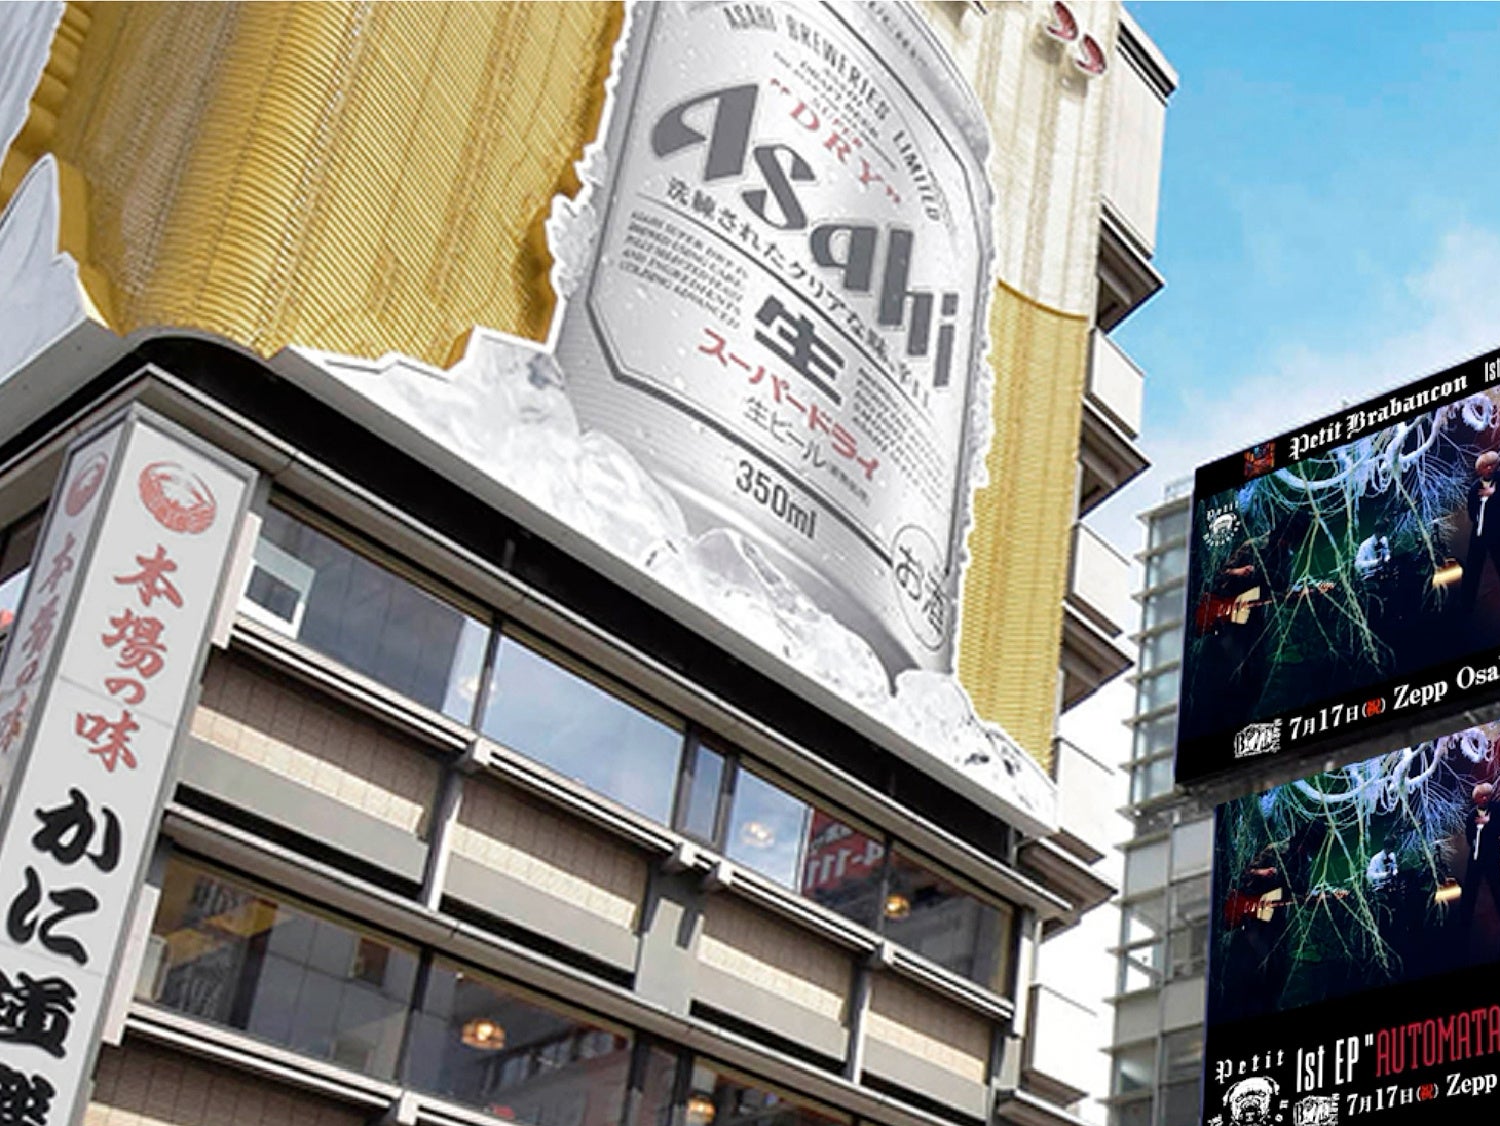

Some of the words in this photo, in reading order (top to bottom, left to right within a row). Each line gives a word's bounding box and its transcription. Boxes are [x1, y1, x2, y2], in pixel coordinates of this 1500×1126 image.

[651, 84, 959, 388] Asahi
[754, 295, 846, 406] 生
[698, 327, 880, 480] スーパードライ
[743, 394, 827, 469] 生ビール
[1289, 419, 1343, 461] Petit
[735, 459, 818, 540] 350ml
[75, 544, 184, 774] 本場の味
[1393, 679, 1449, 712] Zepp
[1215, 1049, 1284, 1084] Petit
[1335, 1036, 1360, 1085] EP
[1446, 1070, 1498, 1100] Zepp
